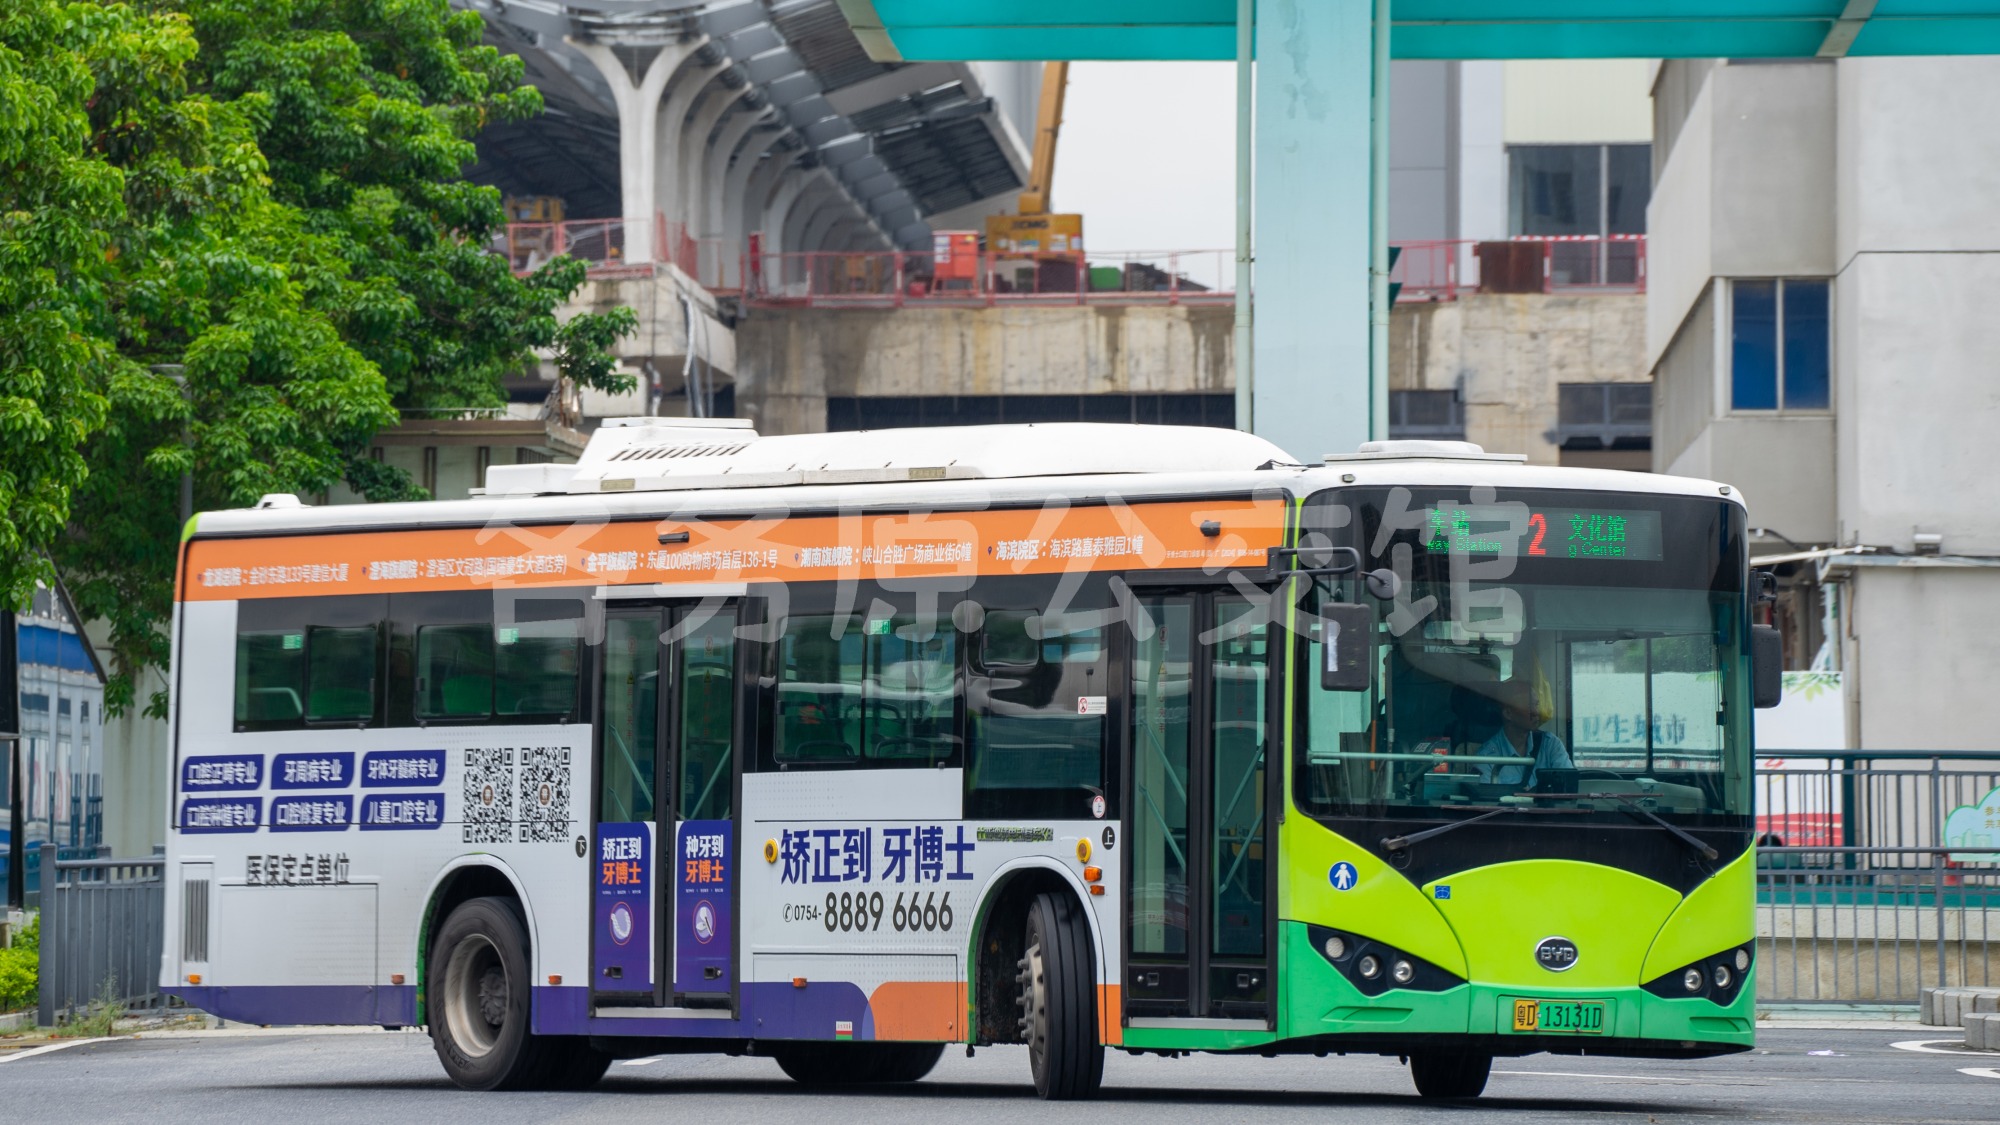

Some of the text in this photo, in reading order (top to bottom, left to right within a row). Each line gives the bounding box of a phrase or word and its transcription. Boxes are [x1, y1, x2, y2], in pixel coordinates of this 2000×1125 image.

[1528, 513, 1546, 555] 2
[1568, 514, 1627, 542] 文化馆
[1456, 538, 1502, 552] Station
[1582, 542, 1626, 556] Center
[283, 758, 343, 783] 牙周病专业
[276, 800, 347, 825] 口腔修复专业
[367, 799, 438, 824] 儿童口腔专业
[577, 839, 585, 854] 下
[602, 836, 642, 860] 矫正到
[685, 834, 724, 858] 种牙到
[1104, 830, 1113, 845] 上
[781, 825, 975, 885] 矫正到 牙博士
[245, 852, 351, 886] 医保定点单位
[602, 862, 642, 885] 牙博士
[685, 859, 724, 884] 牙博士
[892, 891, 953, 932] 6666
[1541, 946, 1574, 961] BYD
